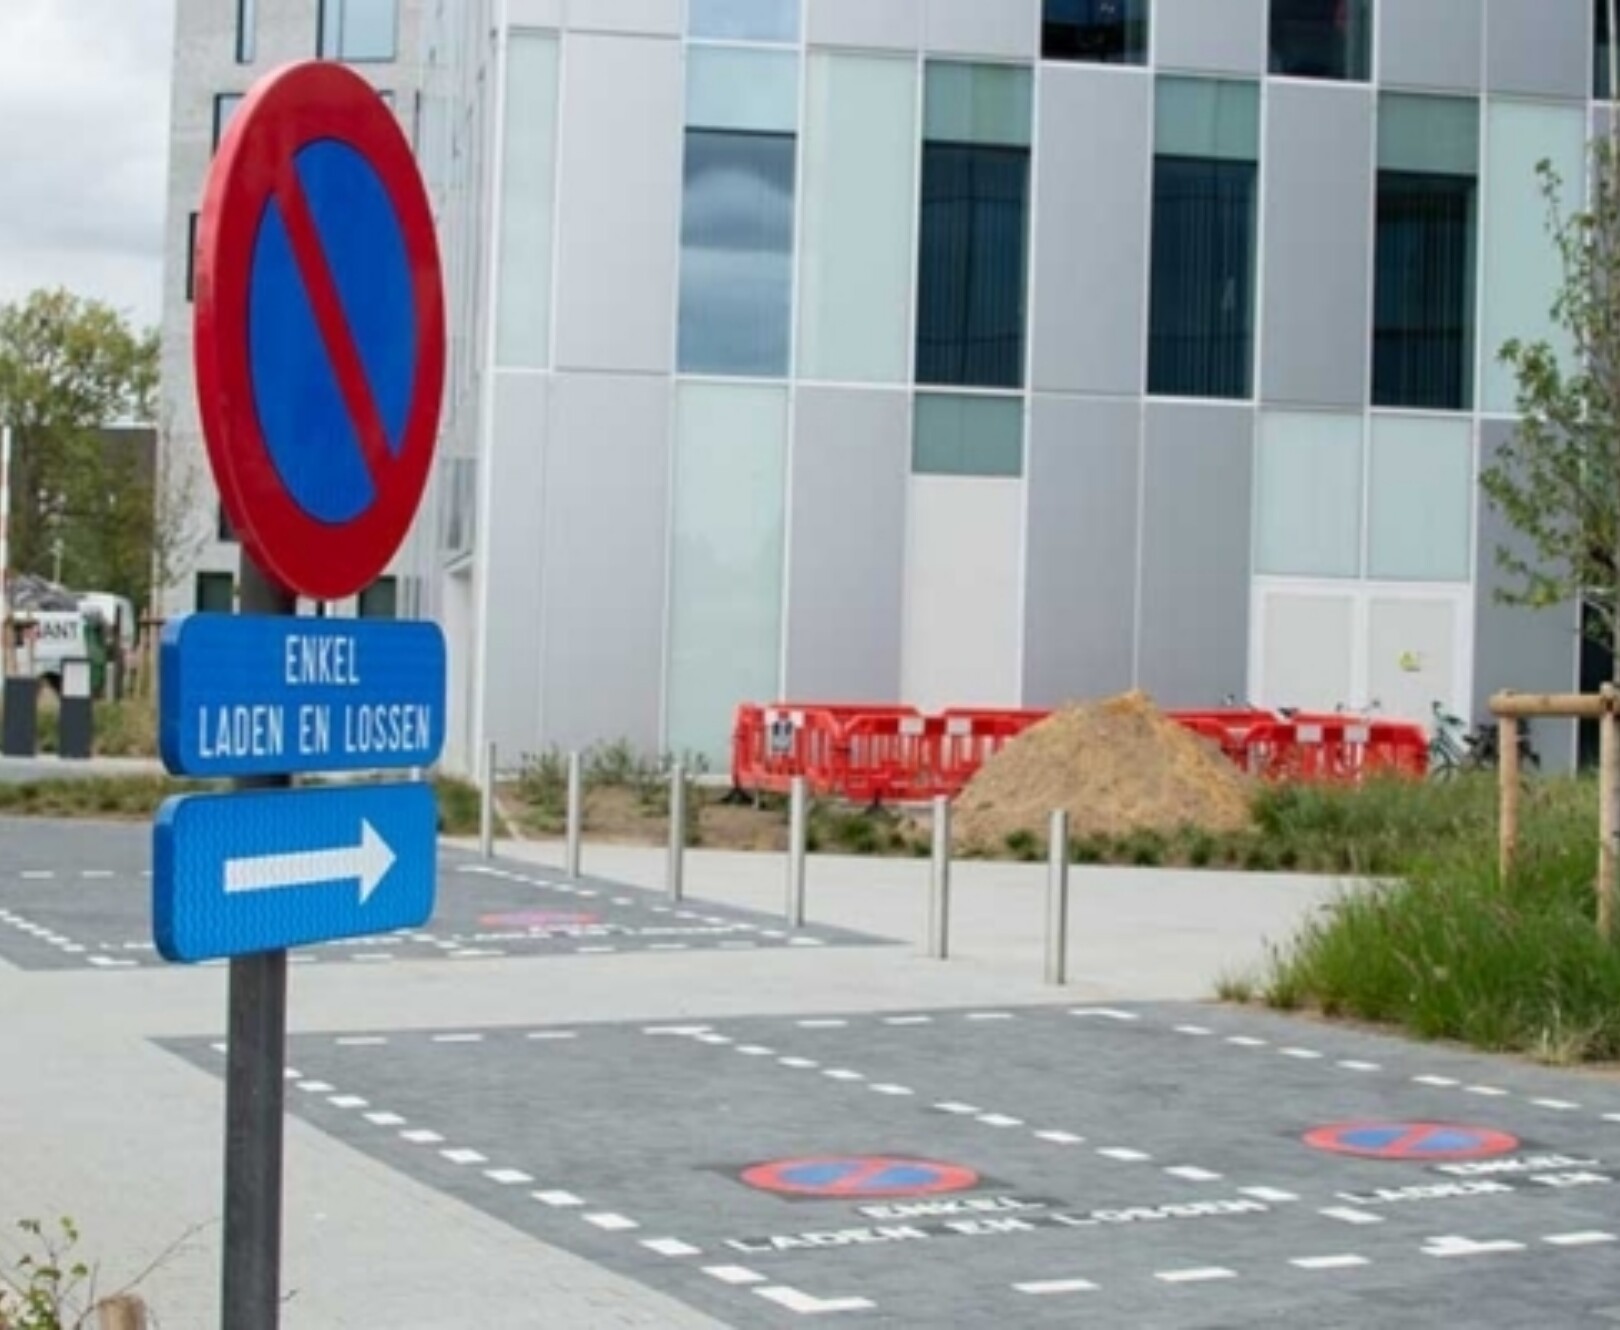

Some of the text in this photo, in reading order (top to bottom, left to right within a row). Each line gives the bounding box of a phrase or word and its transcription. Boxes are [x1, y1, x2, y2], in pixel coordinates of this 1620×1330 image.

[285, 634, 360, 684] ENKEL
[198, 703, 430, 759] LADEN EN LOSSEN
[725, 1225, 928, 1253] LADEN
